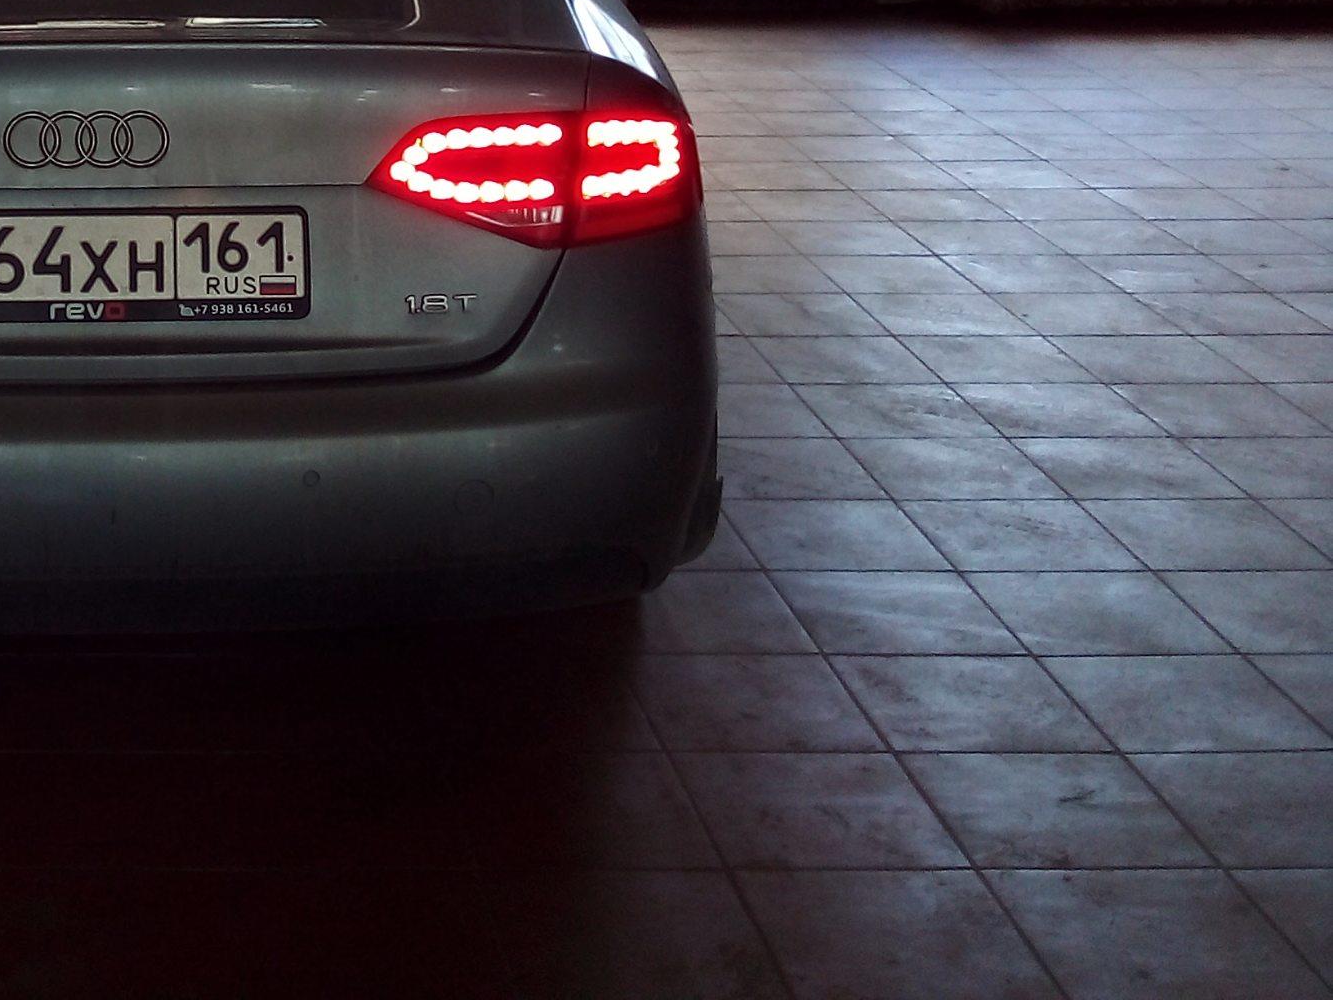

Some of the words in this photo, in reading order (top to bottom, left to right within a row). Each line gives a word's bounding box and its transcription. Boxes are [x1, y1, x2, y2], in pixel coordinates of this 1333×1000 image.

[182, 221, 285, 273] 161
[205, 276, 257, 295] RUS
[194, 304, 209, 315] +7
[211, 304, 234, 315] 938
[236, 303, 295, 315] 161-5461
